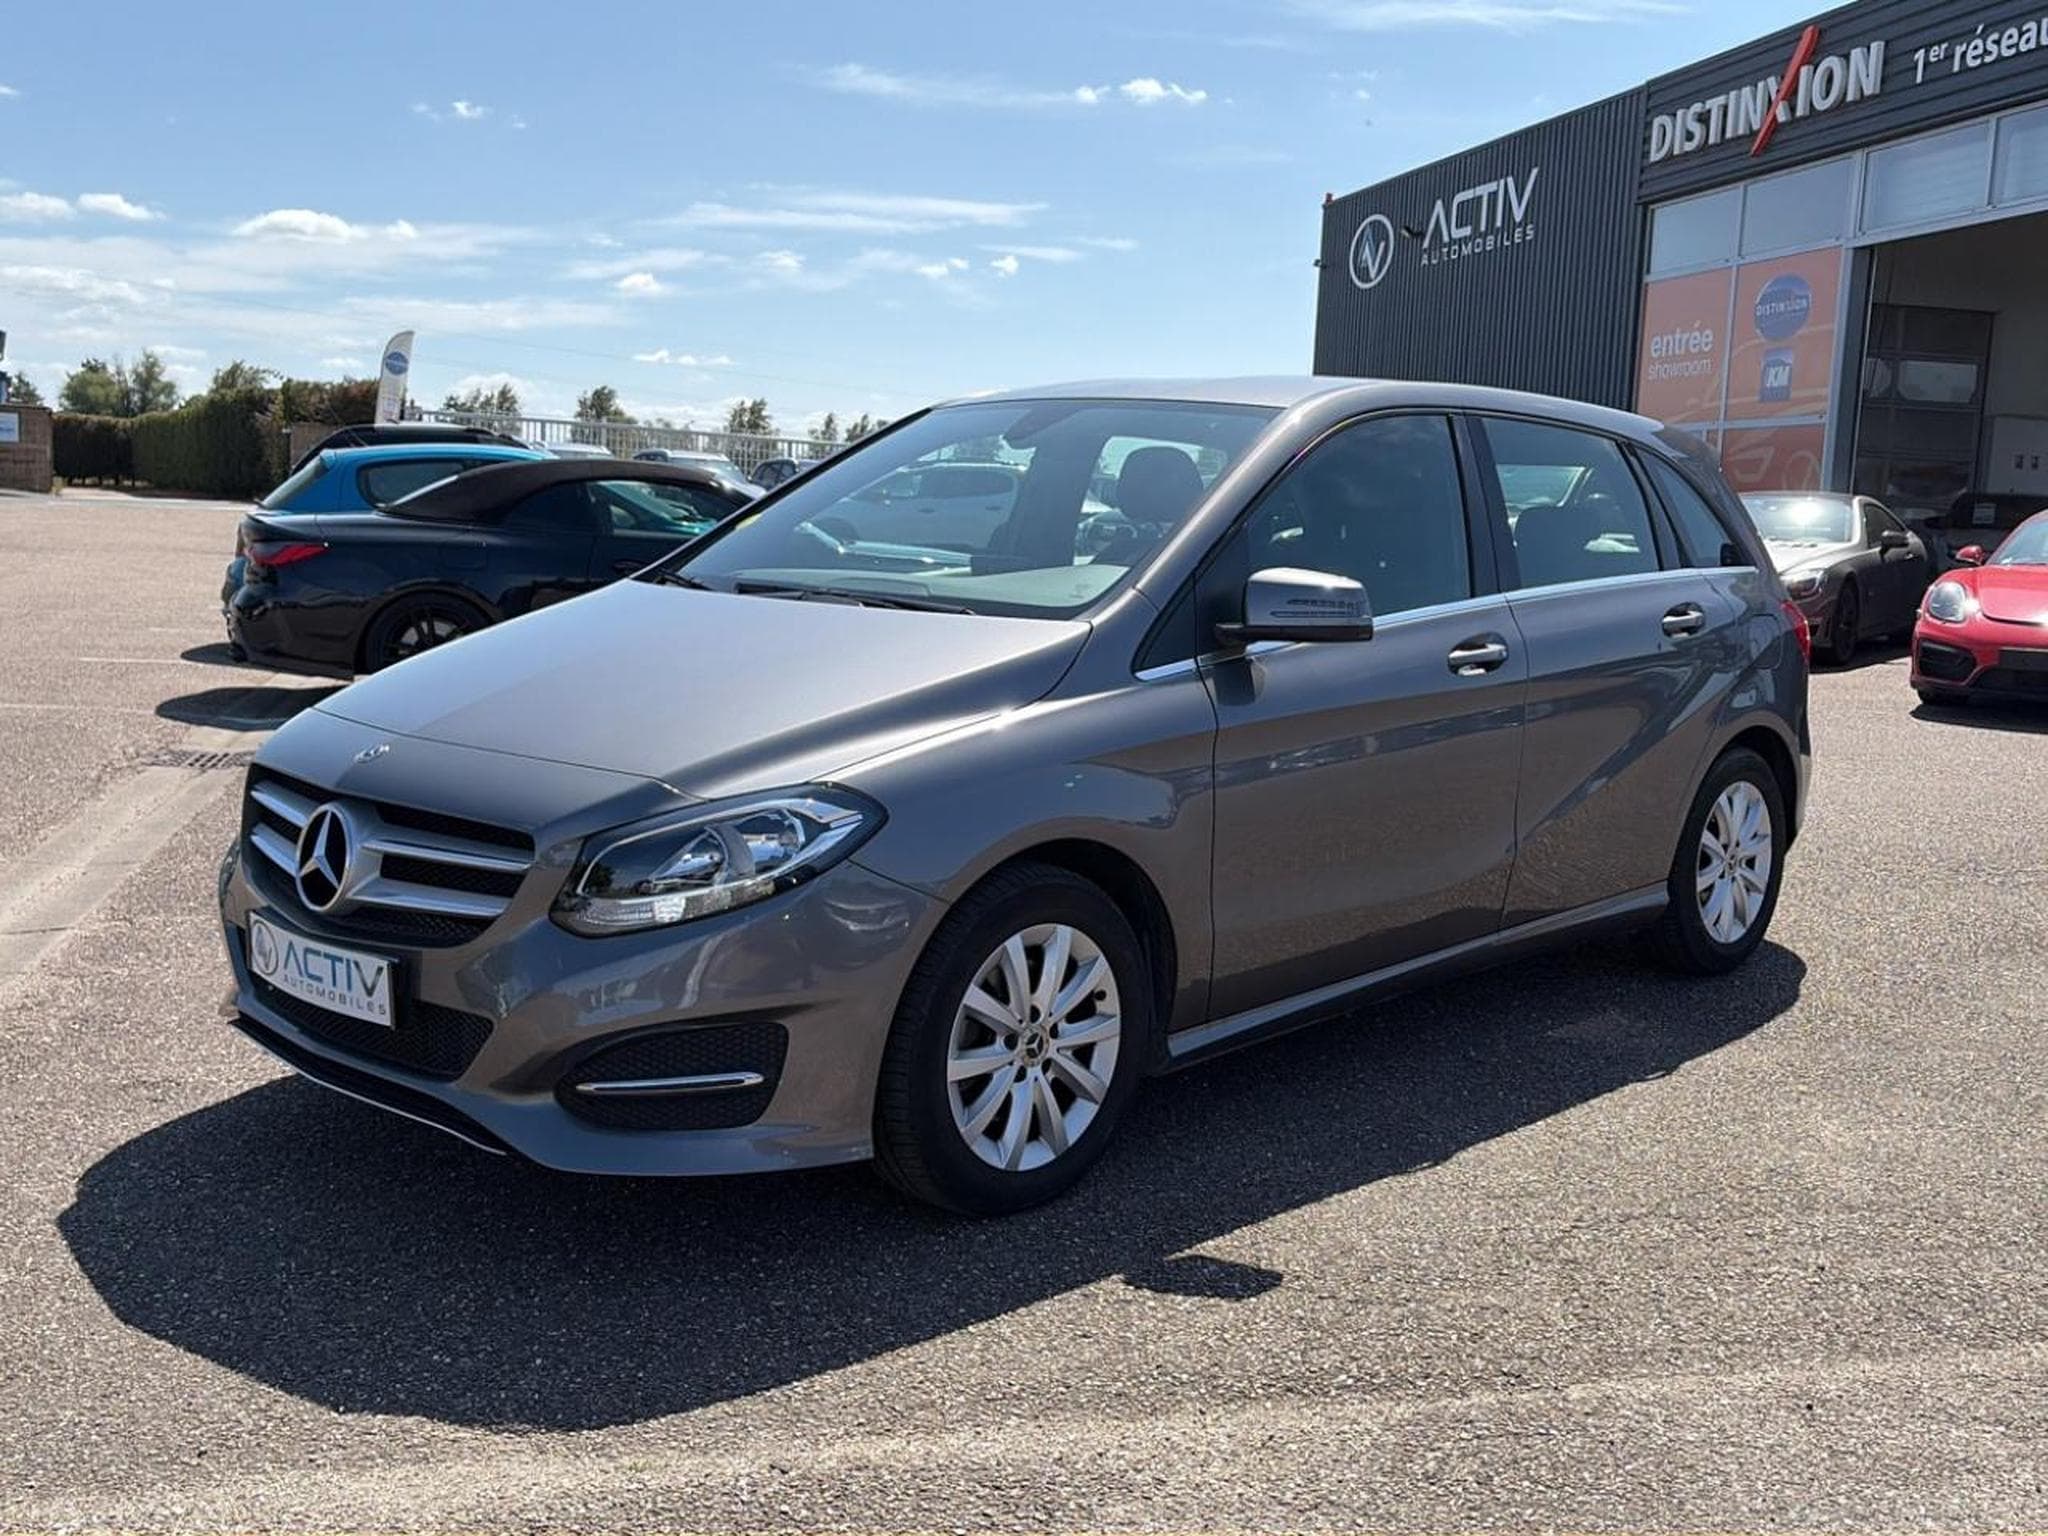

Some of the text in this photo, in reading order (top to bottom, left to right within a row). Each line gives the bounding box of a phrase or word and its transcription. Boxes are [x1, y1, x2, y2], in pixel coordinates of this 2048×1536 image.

[1650, 25, 1886, 162] DISTINXION
[1422, 167, 1539, 249] ACTIV
[1420, 224, 1536, 267] AUTOMOBILES
[1651, 320, 1714, 359] entrée
[1648, 358, 1713, 381] showroom
[284, 940, 384, 998] ACTIV
[283, 973, 387, 1016] AUTOMOBILES
